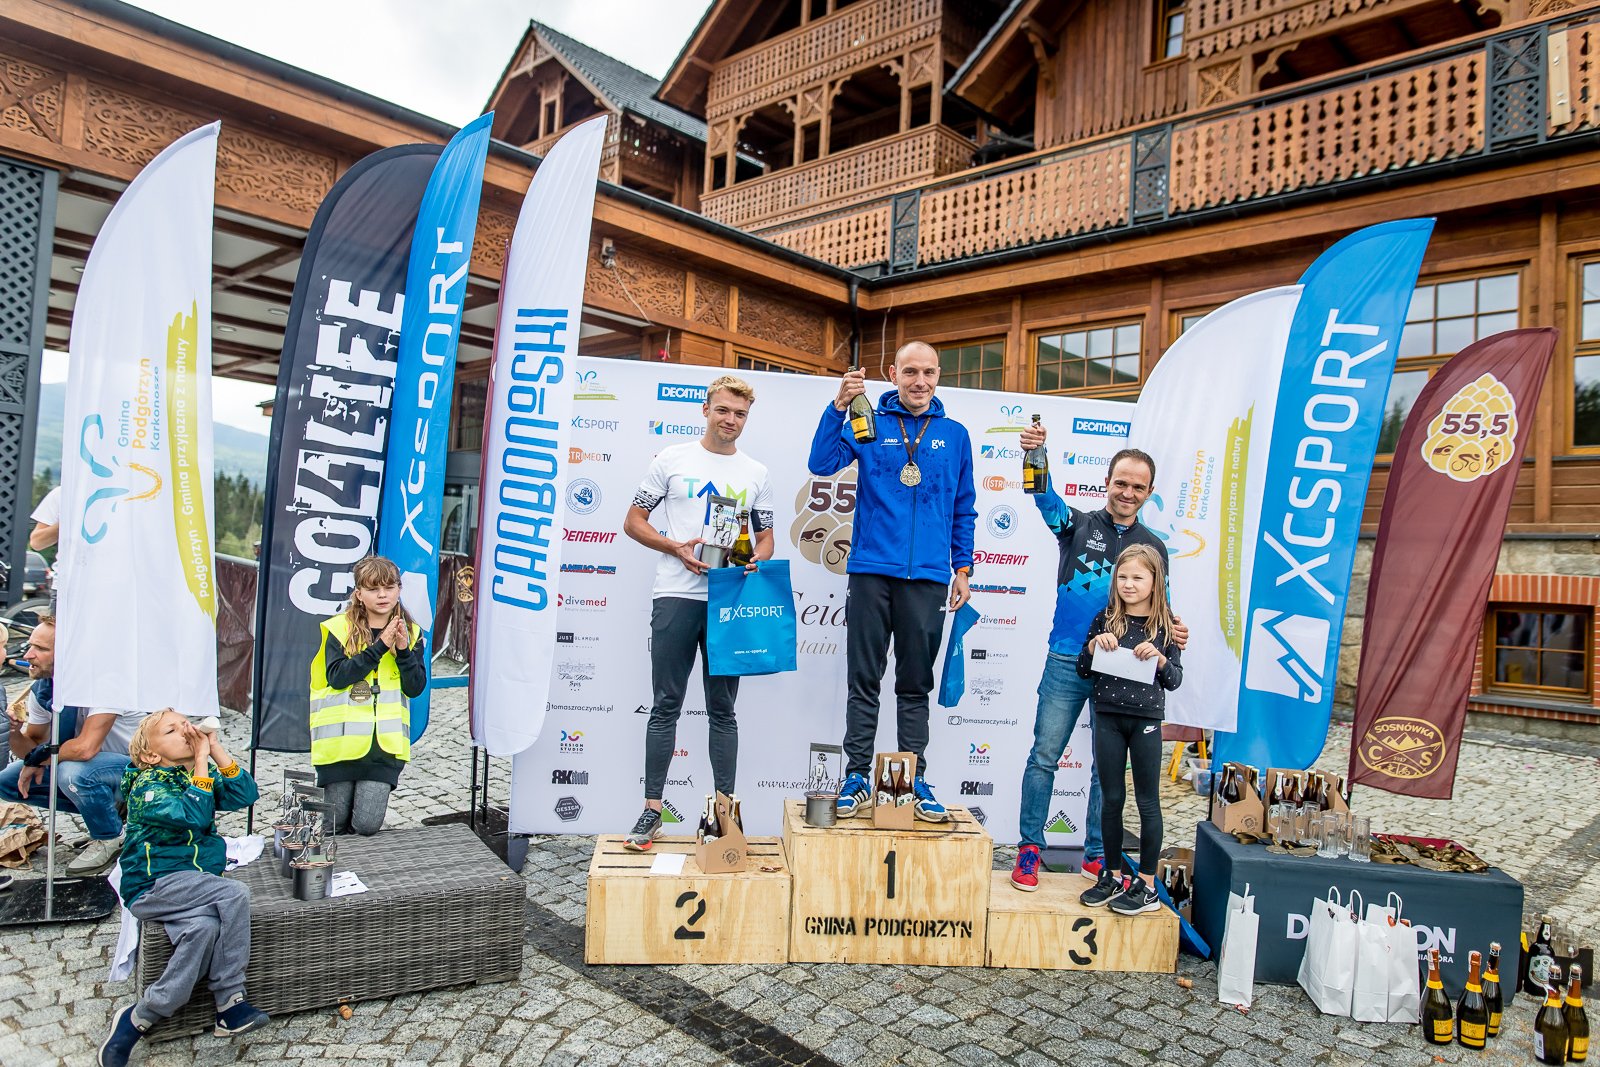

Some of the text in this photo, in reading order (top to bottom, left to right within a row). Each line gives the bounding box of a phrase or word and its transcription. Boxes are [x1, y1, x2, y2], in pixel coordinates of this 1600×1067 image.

[175, 338, 190, 383] natury
[132, 358, 150, 449] Podgórzyn
[150, 366, 160, 450] Karkonosze
[176, 388, 186, 396] z
[118, 400, 130, 447] Gmina
[171, 400, 190, 468] przyjazna
[571, 416, 620, 432] XCSPORT
[1076, 421, 1128, 434] DECATHLON
[1441, 414, 1510, 438] 55,5
[288, 279, 405, 616] GO4LIFE
[1232, 436, 1244, 470] natury
[1264, 308, 1388, 605] XCSPORT
[182, 472, 194, 516] Gmina
[1176, 482, 1188, 518] Gmina
[1187, 450, 1205, 519] Podgórzyn
[1199, 456, 1215, 520] Karkonosze
[1228, 481, 1240, 532] przyjazna
[568, 530, 617, 543] ENERVIT
[1226, 536, 1235, 570] Gmina
[192, 529, 210, 598] Podgórzyn
[986, 554, 1029, 566] ENERVIT
[565, 596, 606, 606] divemed
[732, 604, 784, 620] XCSPORT
[1228, 580, 1236, 636] Podgórzyn
[981, 615, 1016, 624] divemed
[1374, 722, 1434, 740] SOSNÓWKA
[1368, 746, 1382, 760] C
[1420, 752, 1432, 766] S
[662, 800, 685, 822] MERLIN
[1044, 810, 1078, 832] LEROY MERLIN
[884, 850, 896, 898] 1
[674, 891, 706, 940] 2
[805, 916, 972, 938] GMINA PODGORZYN
[1068, 918, 1098, 965] 3
